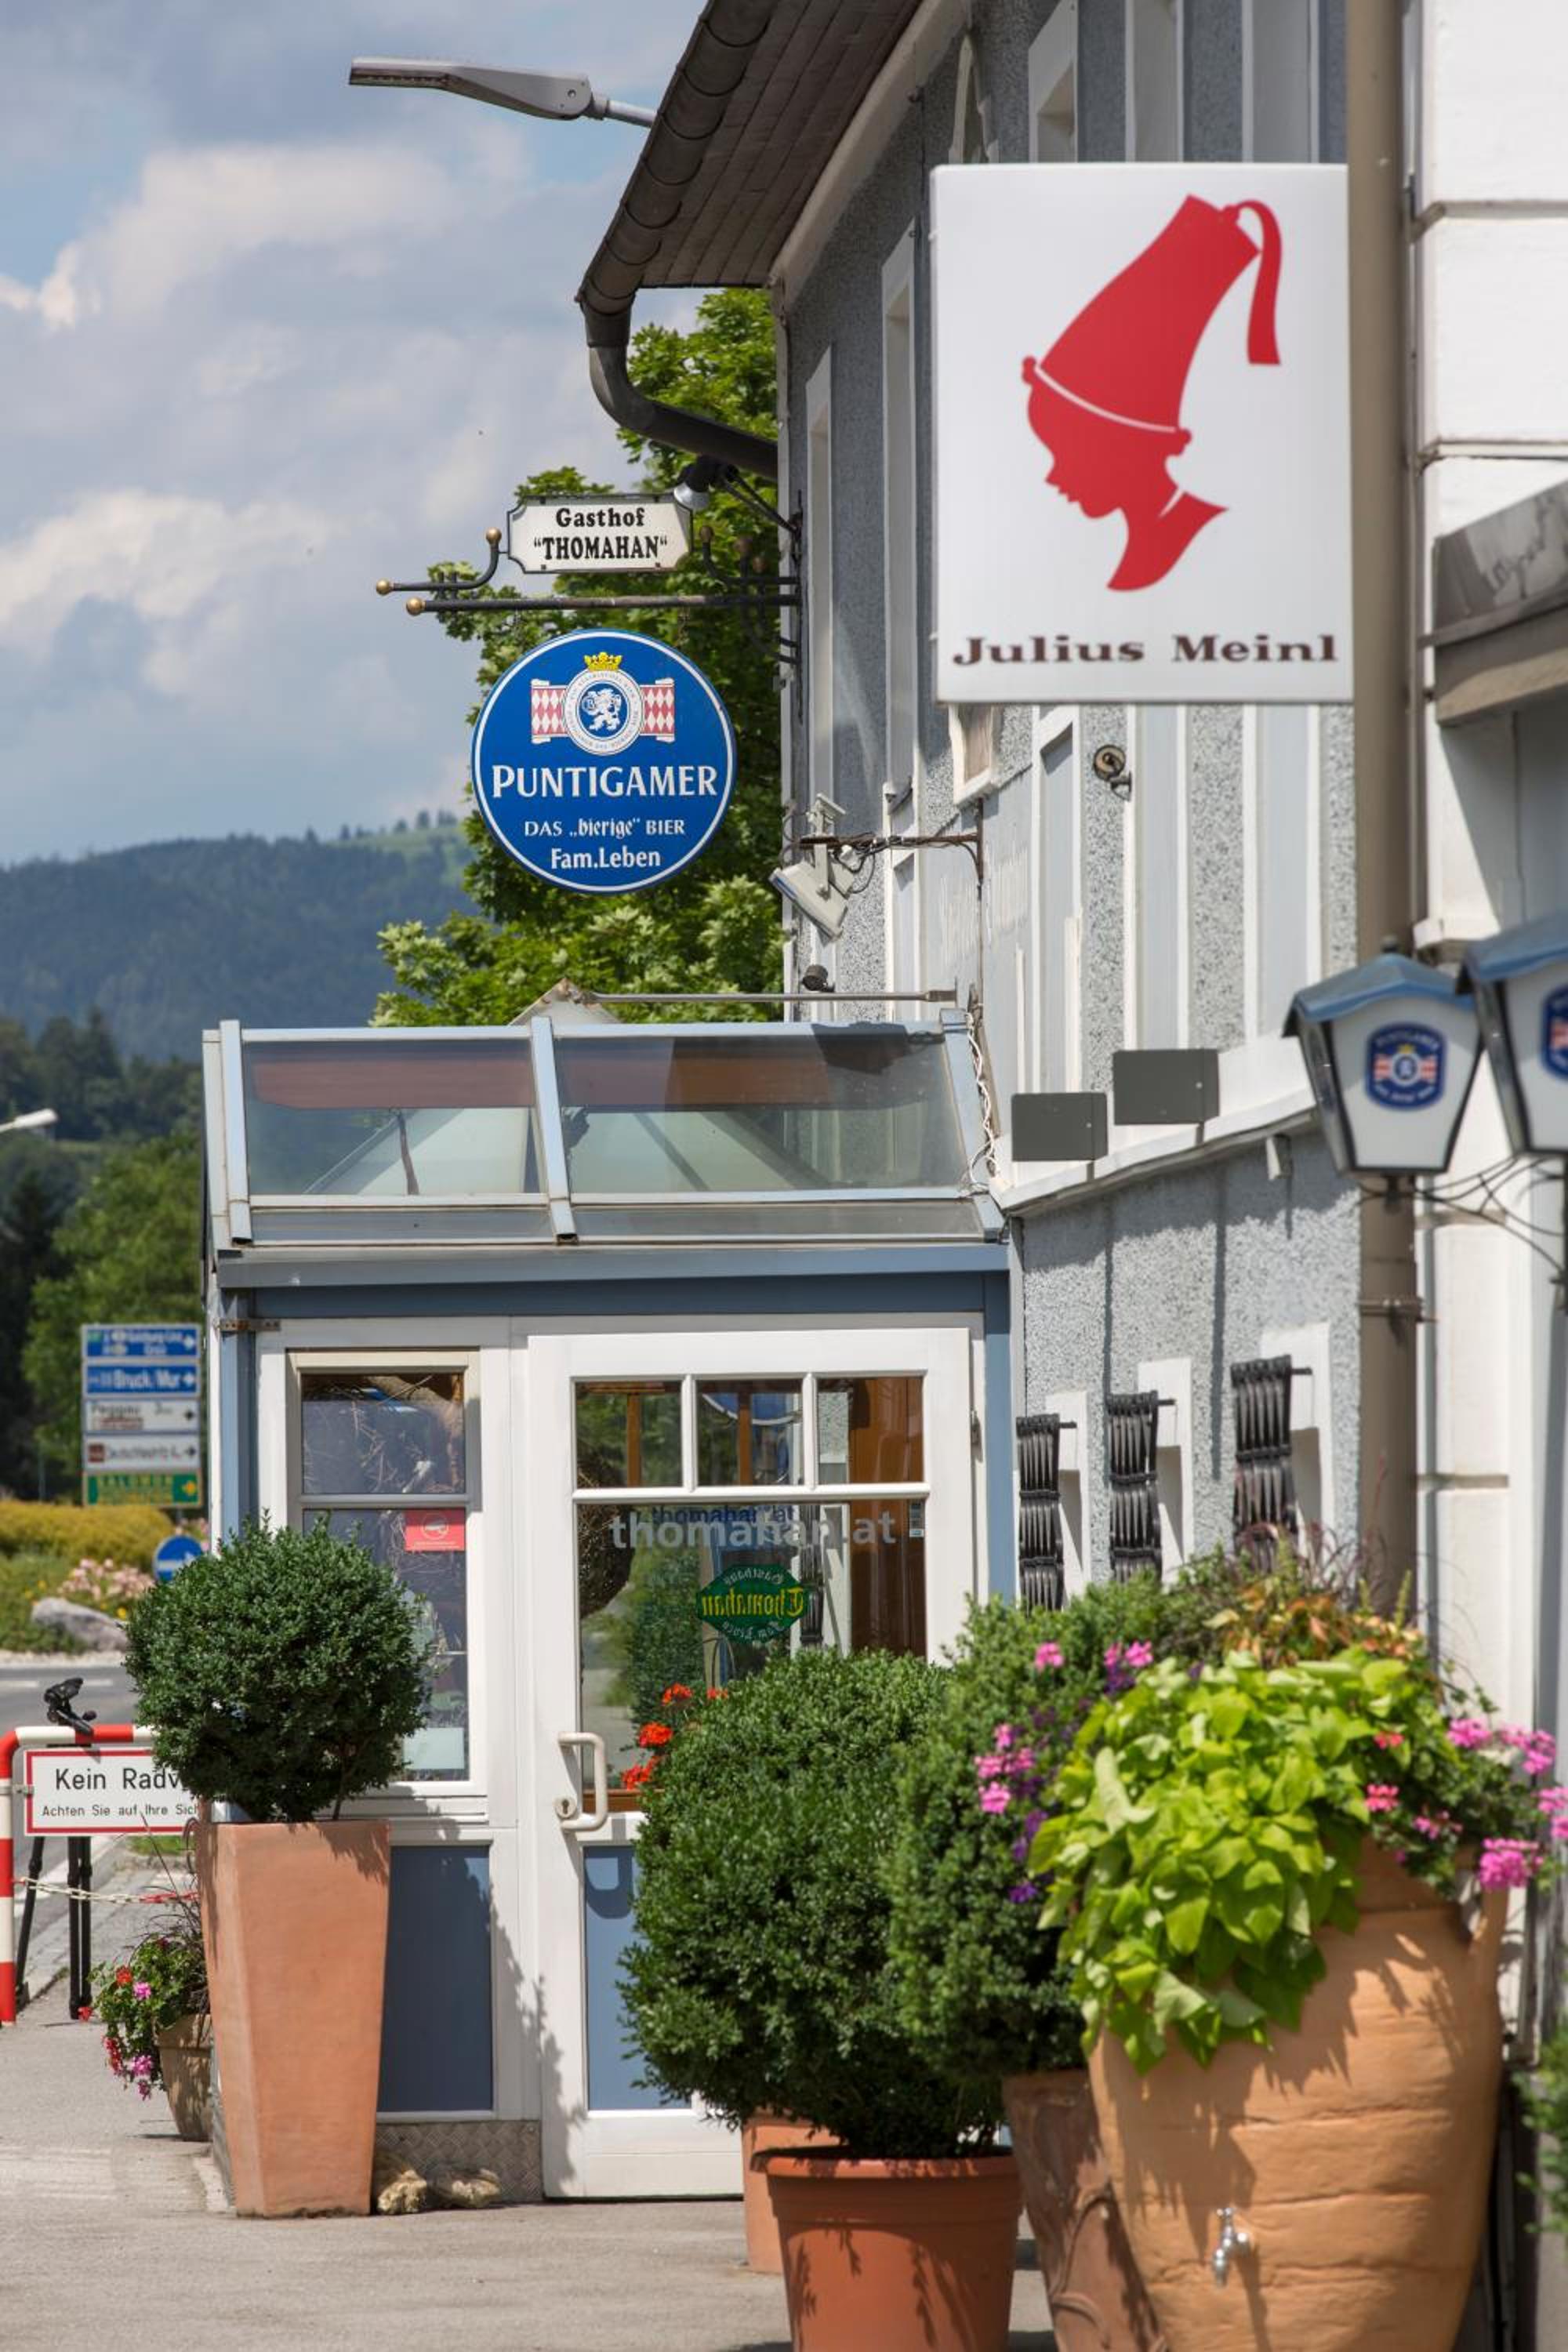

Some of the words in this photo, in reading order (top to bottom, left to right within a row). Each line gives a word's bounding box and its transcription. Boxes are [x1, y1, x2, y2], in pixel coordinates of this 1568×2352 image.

[556, 507, 645, 527] Gasthof
[953, 634, 1145, 666] Julius
[1172, 634, 1338, 662] Meinl
[492, 764, 718, 798] PUNTIGAMER
[524, 821, 563, 837] DAS
[645, 819, 685, 835] BIER
[608, 1510, 897, 1548] thomahan.at
[56, 1768, 107, 1790] Kein
[42, 1805, 85, 1817] Achten
[92, 1804, 111, 1817] Sie
[118, 1804, 137, 1816] auf
[145, 1804, 168, 1816] Ihre
